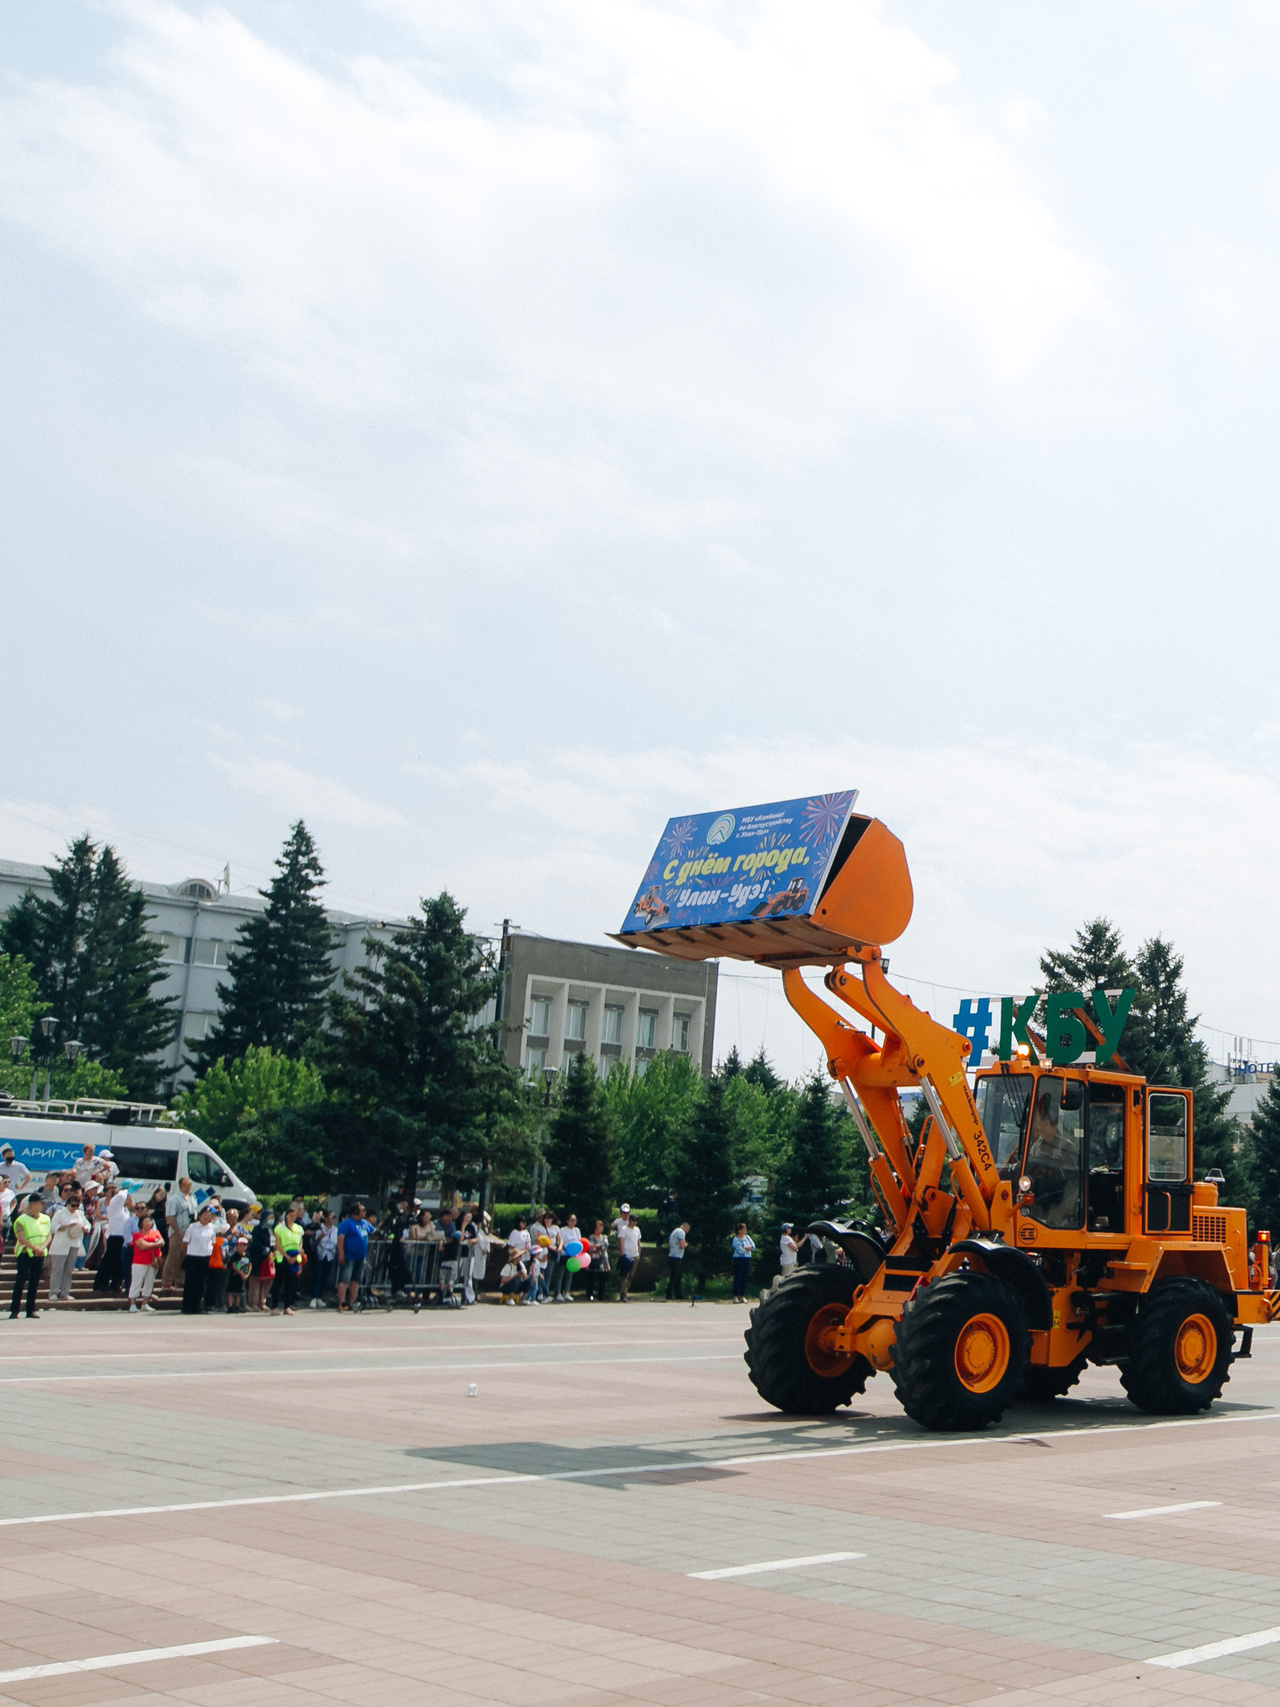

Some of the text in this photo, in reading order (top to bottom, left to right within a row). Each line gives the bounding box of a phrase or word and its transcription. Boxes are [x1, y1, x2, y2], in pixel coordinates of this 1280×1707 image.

[662, 846, 811, 886] С днём города,
[676, 879, 770, 908] Улан-Удэ!
[953, 988, 1136, 1067] #КБУ
[1237, 1061, 1277, 1076] HOTE
